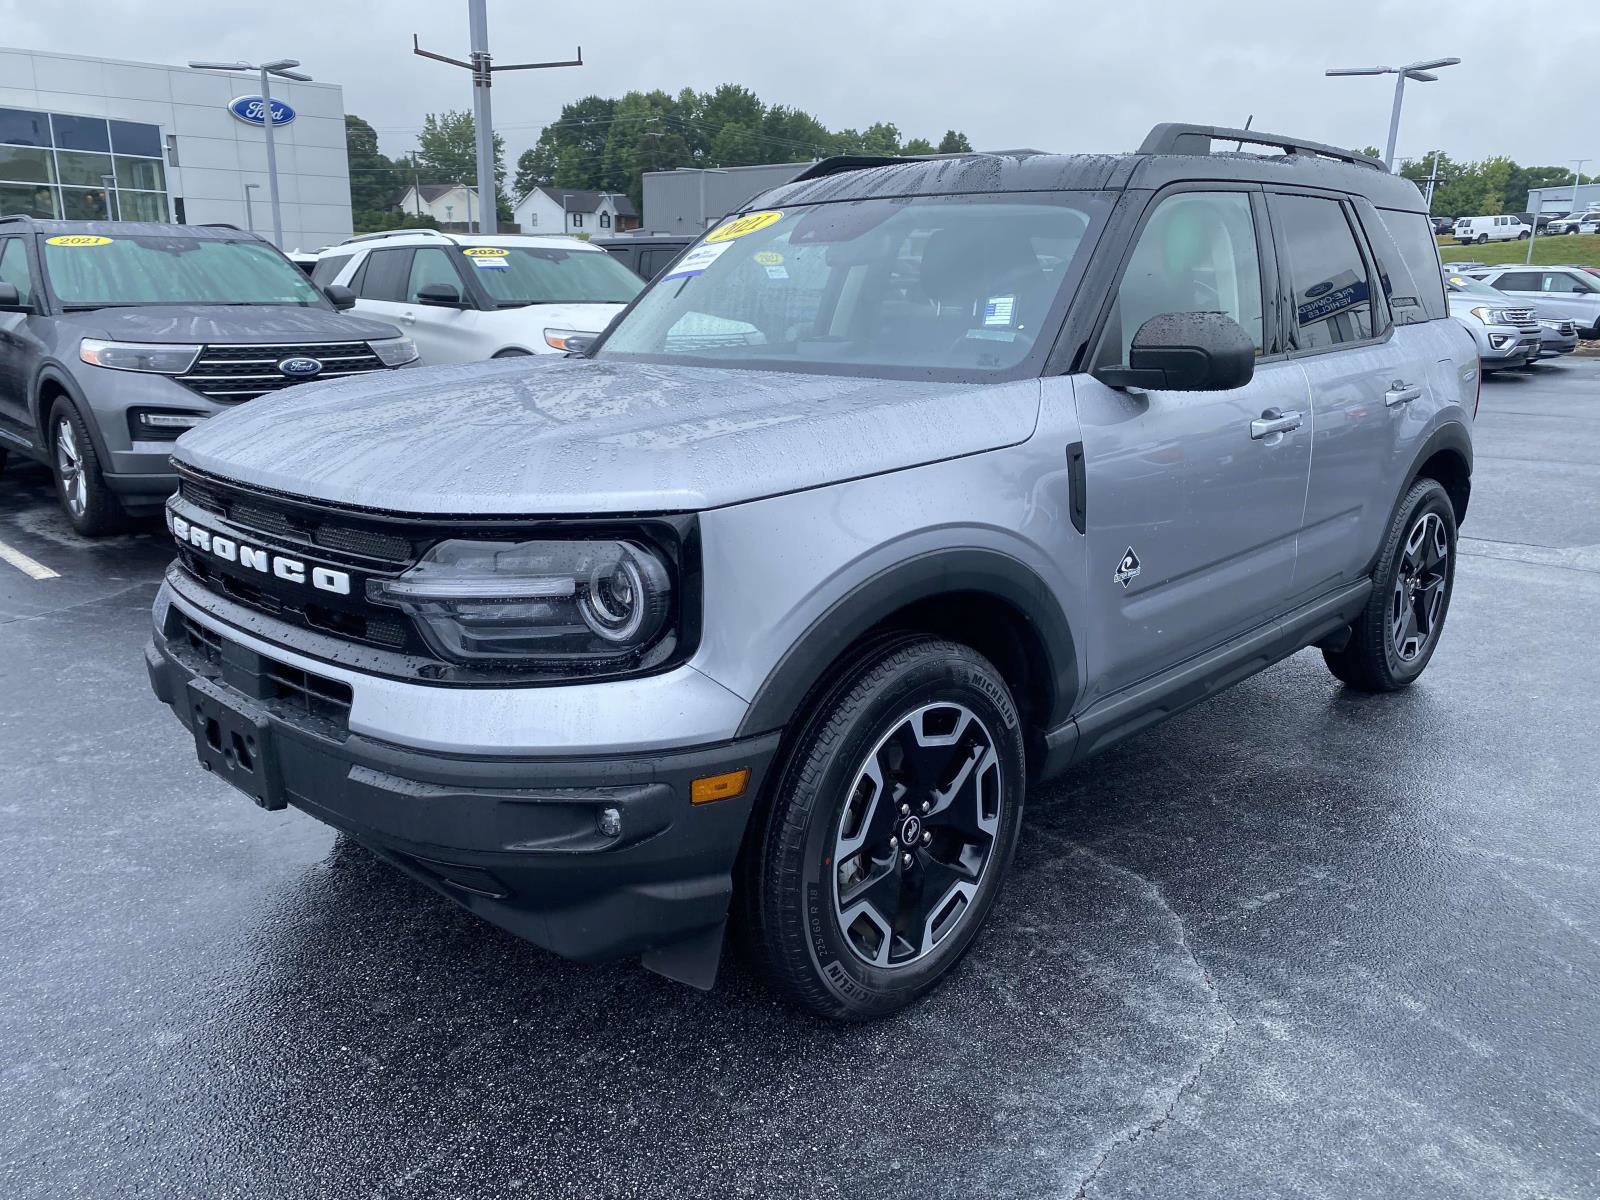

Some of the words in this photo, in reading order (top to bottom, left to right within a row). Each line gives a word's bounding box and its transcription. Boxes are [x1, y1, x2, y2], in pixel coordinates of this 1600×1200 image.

[59, 237, 101, 245] 2021
[711, 214, 774, 240] 2021
[173, 516, 351, 595] BRONCO
[971, 673, 1016, 726] MICHELIN
[828, 964, 879, 1005] ICHELIN
